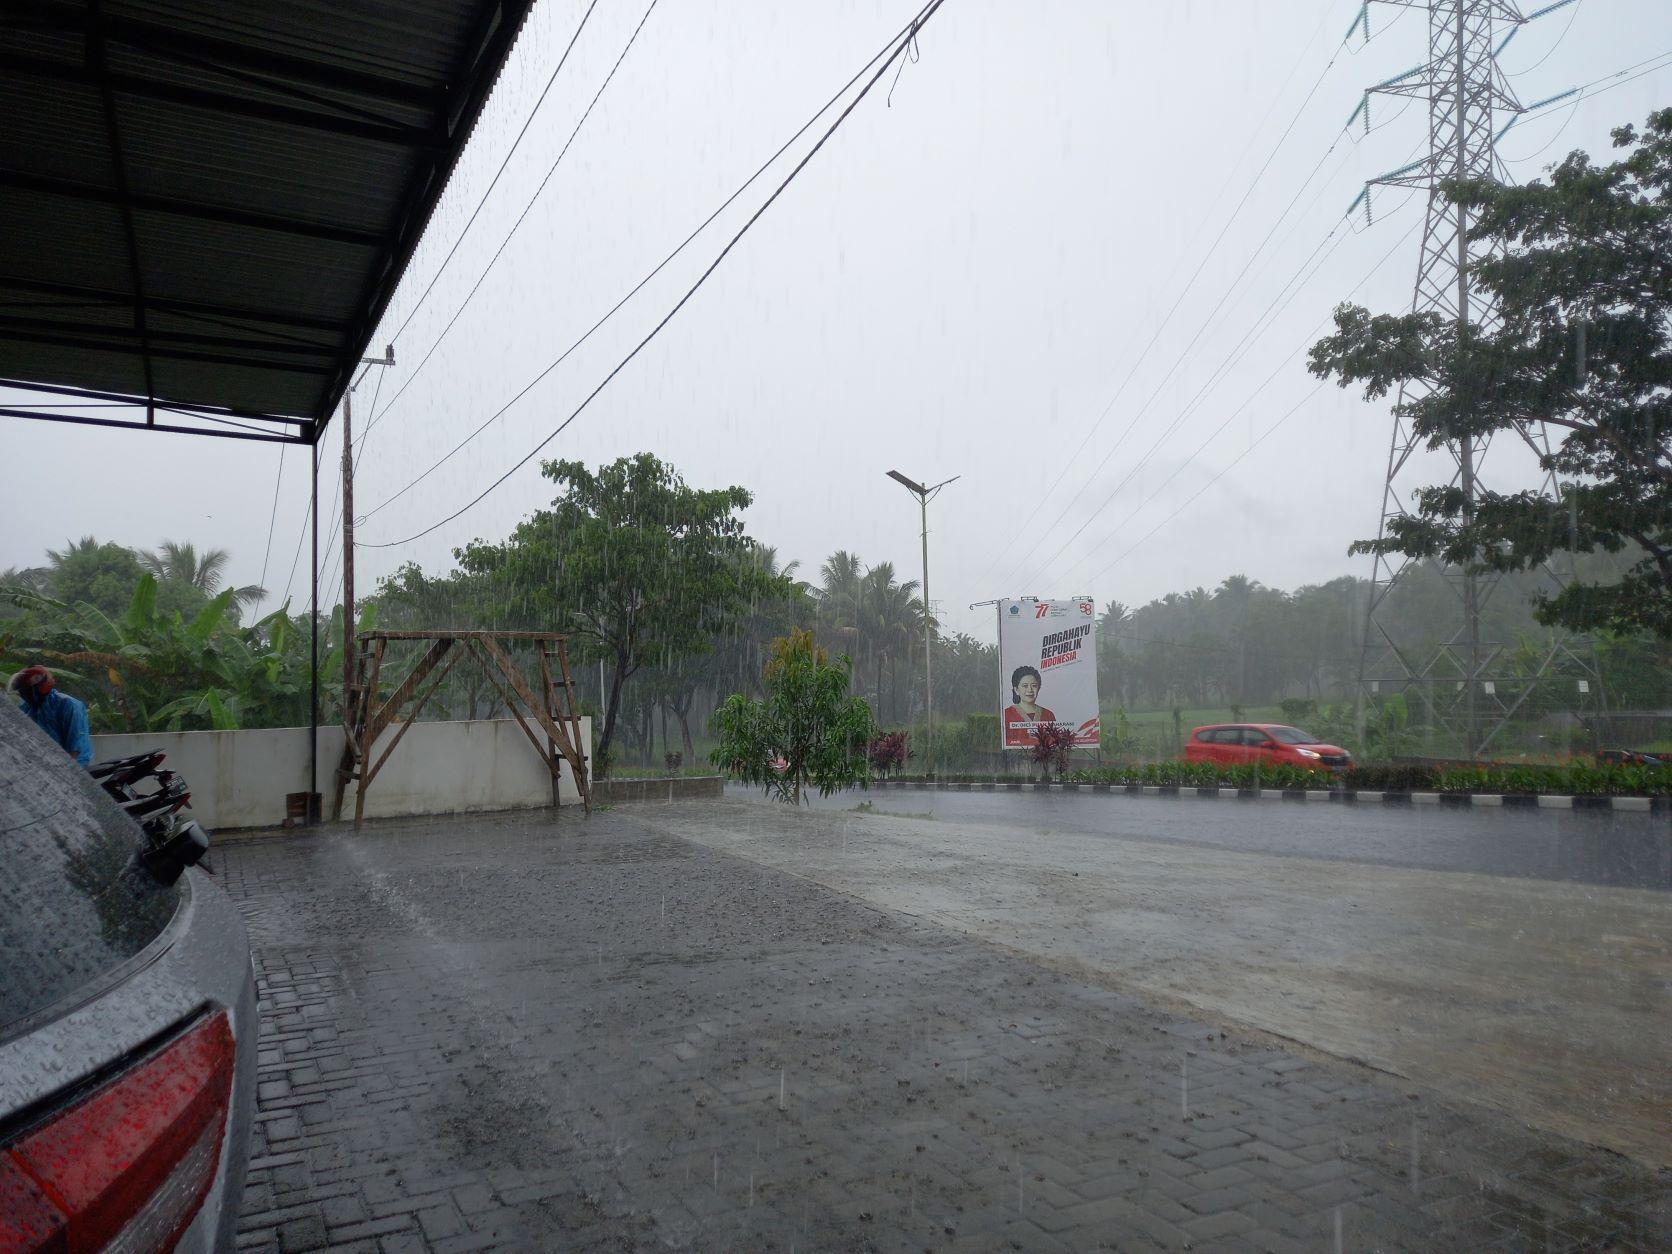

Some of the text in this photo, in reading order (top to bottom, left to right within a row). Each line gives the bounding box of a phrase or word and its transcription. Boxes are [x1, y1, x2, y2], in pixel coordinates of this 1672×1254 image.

[1042, 623, 1091, 647] DIRGAHAYU
[1040, 650, 1077, 669] INDONESIA
[1041, 637, 1082, 660] REPUBLIK
